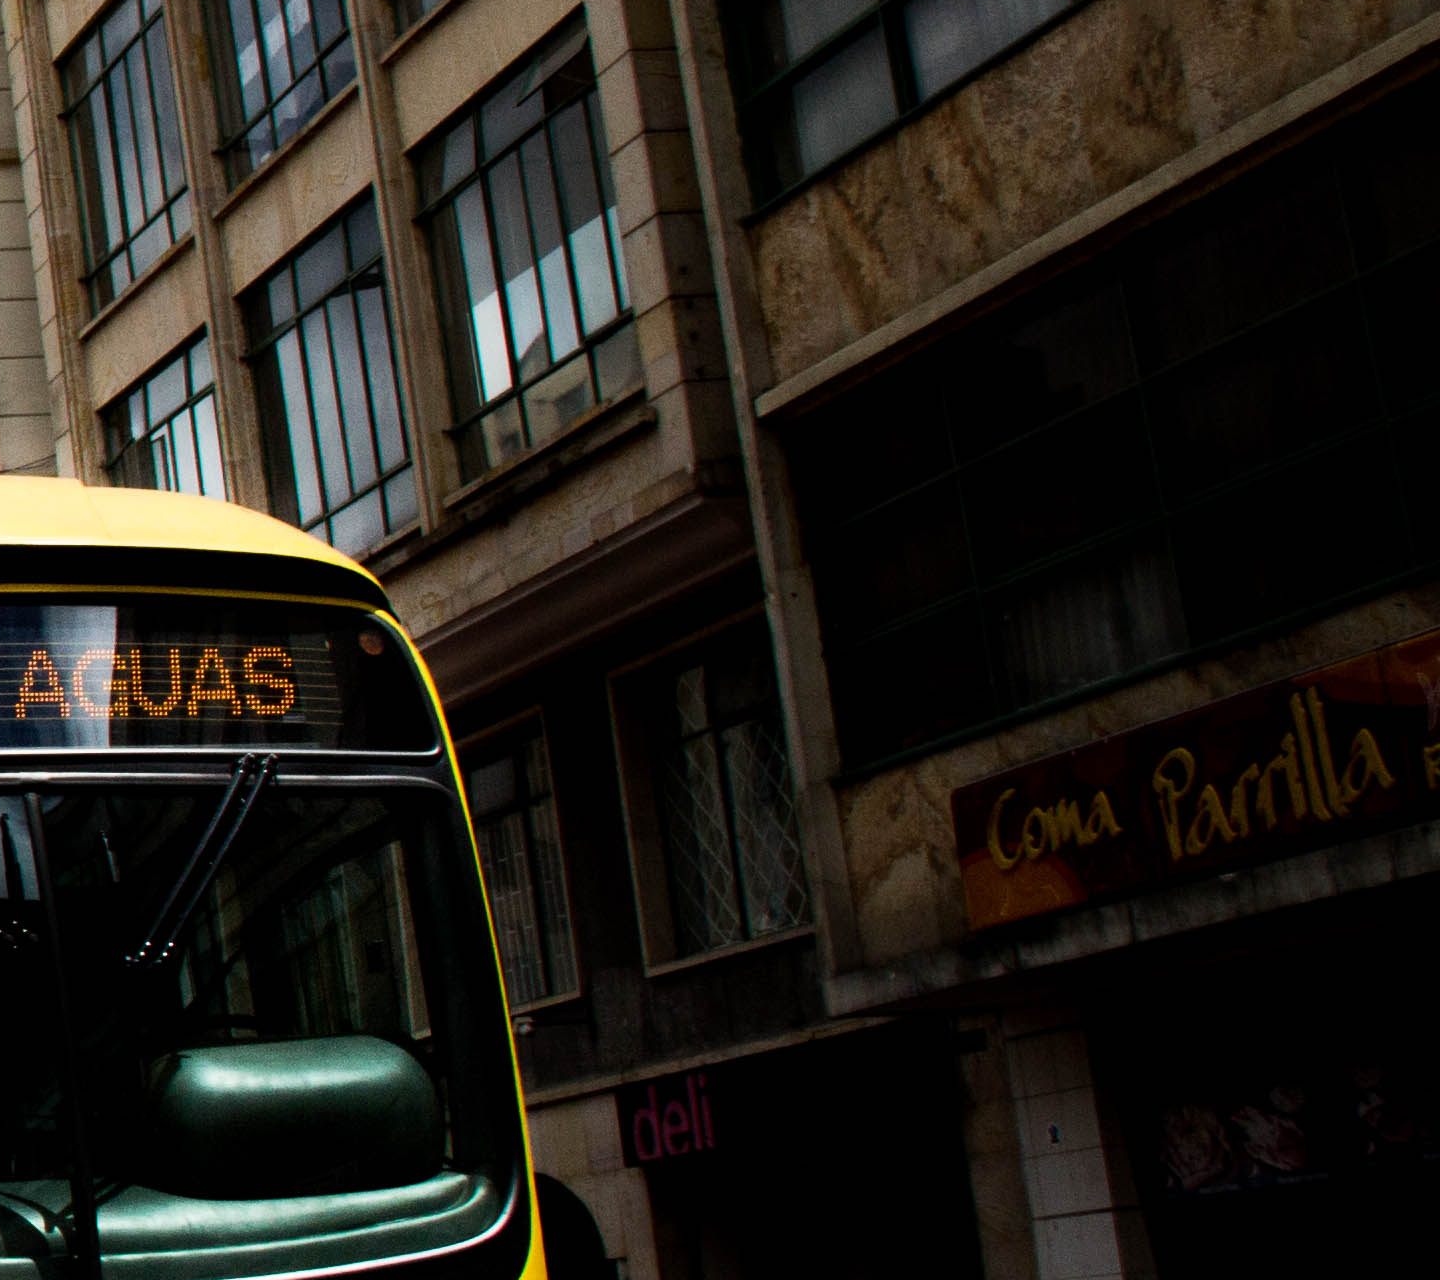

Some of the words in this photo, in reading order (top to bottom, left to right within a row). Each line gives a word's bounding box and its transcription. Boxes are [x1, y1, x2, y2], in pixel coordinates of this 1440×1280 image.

[14, 645, 297, 720] AGUAS
[985, 787, 1124, 871] Coma
[1150, 684, 1397, 863] Parrilla
[632, 1071, 717, 1162] deli
